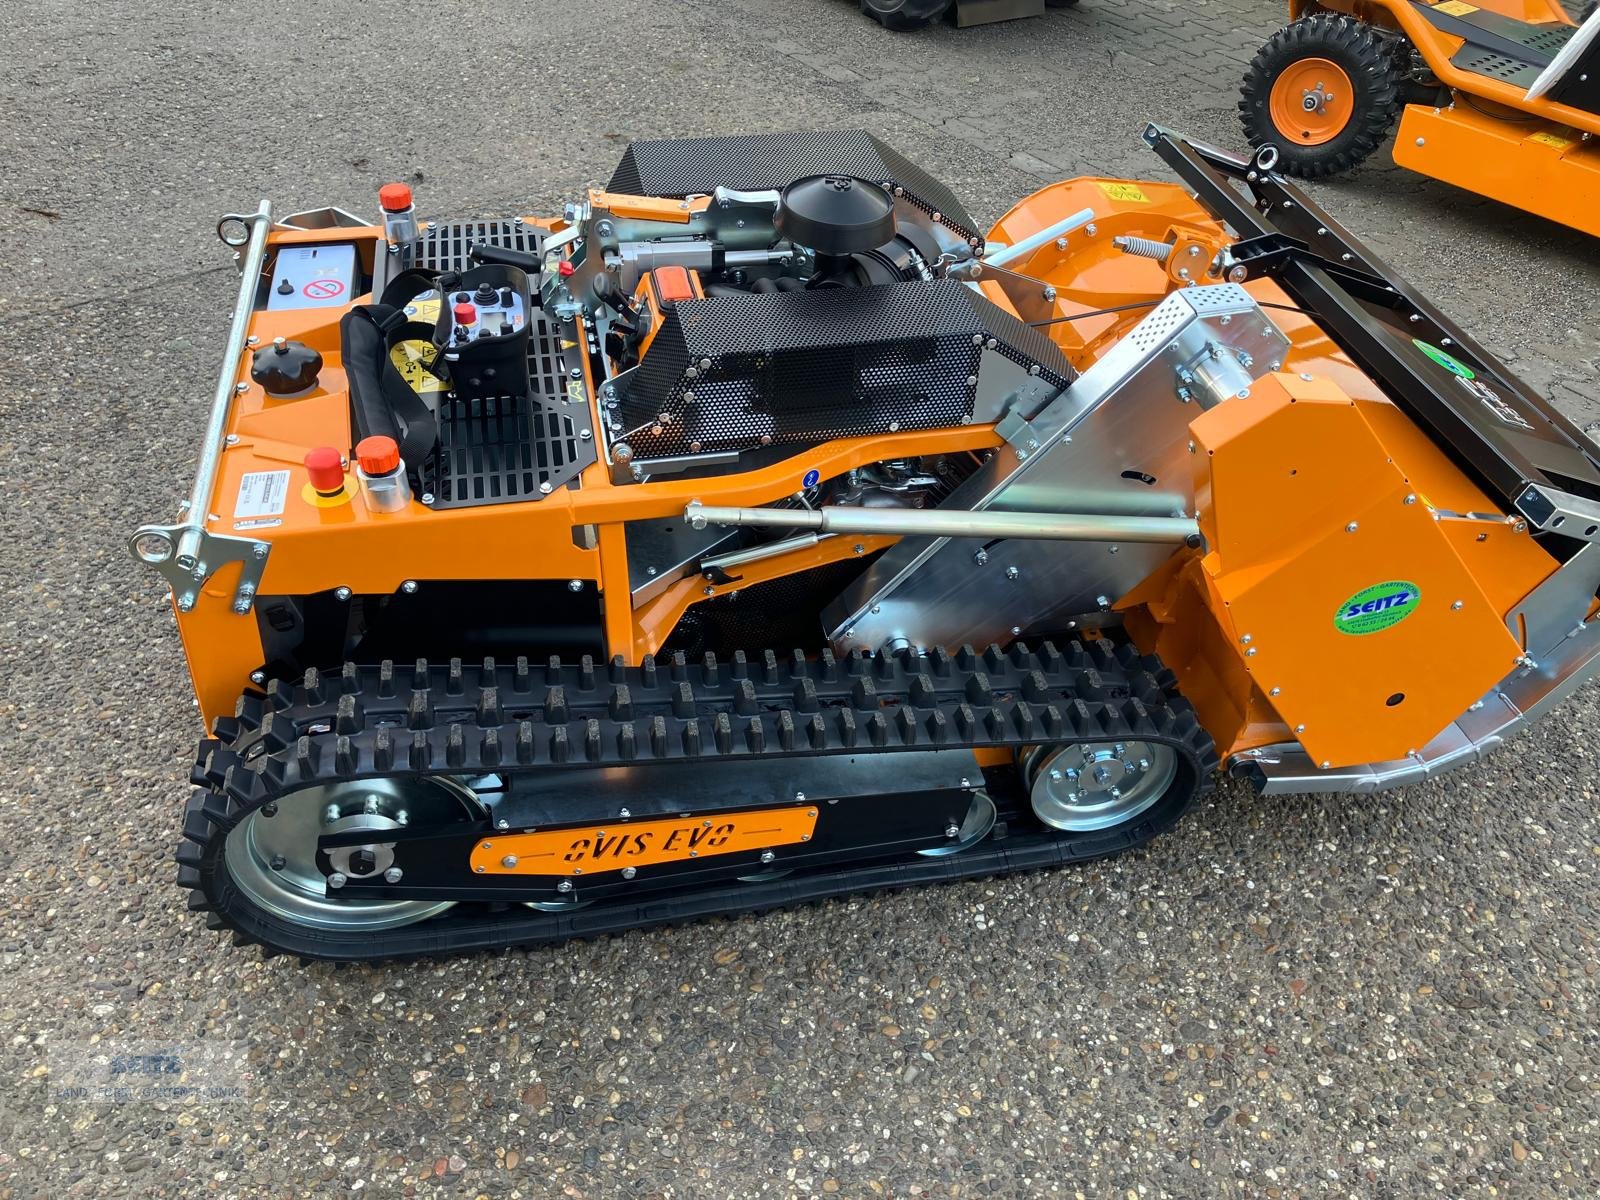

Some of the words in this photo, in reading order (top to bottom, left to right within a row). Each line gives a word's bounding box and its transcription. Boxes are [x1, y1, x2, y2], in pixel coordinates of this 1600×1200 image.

[1346, 592, 1410, 618] SEITZ
[563, 832, 654, 863] OVIS
[662, 823, 736, 852] EVO
